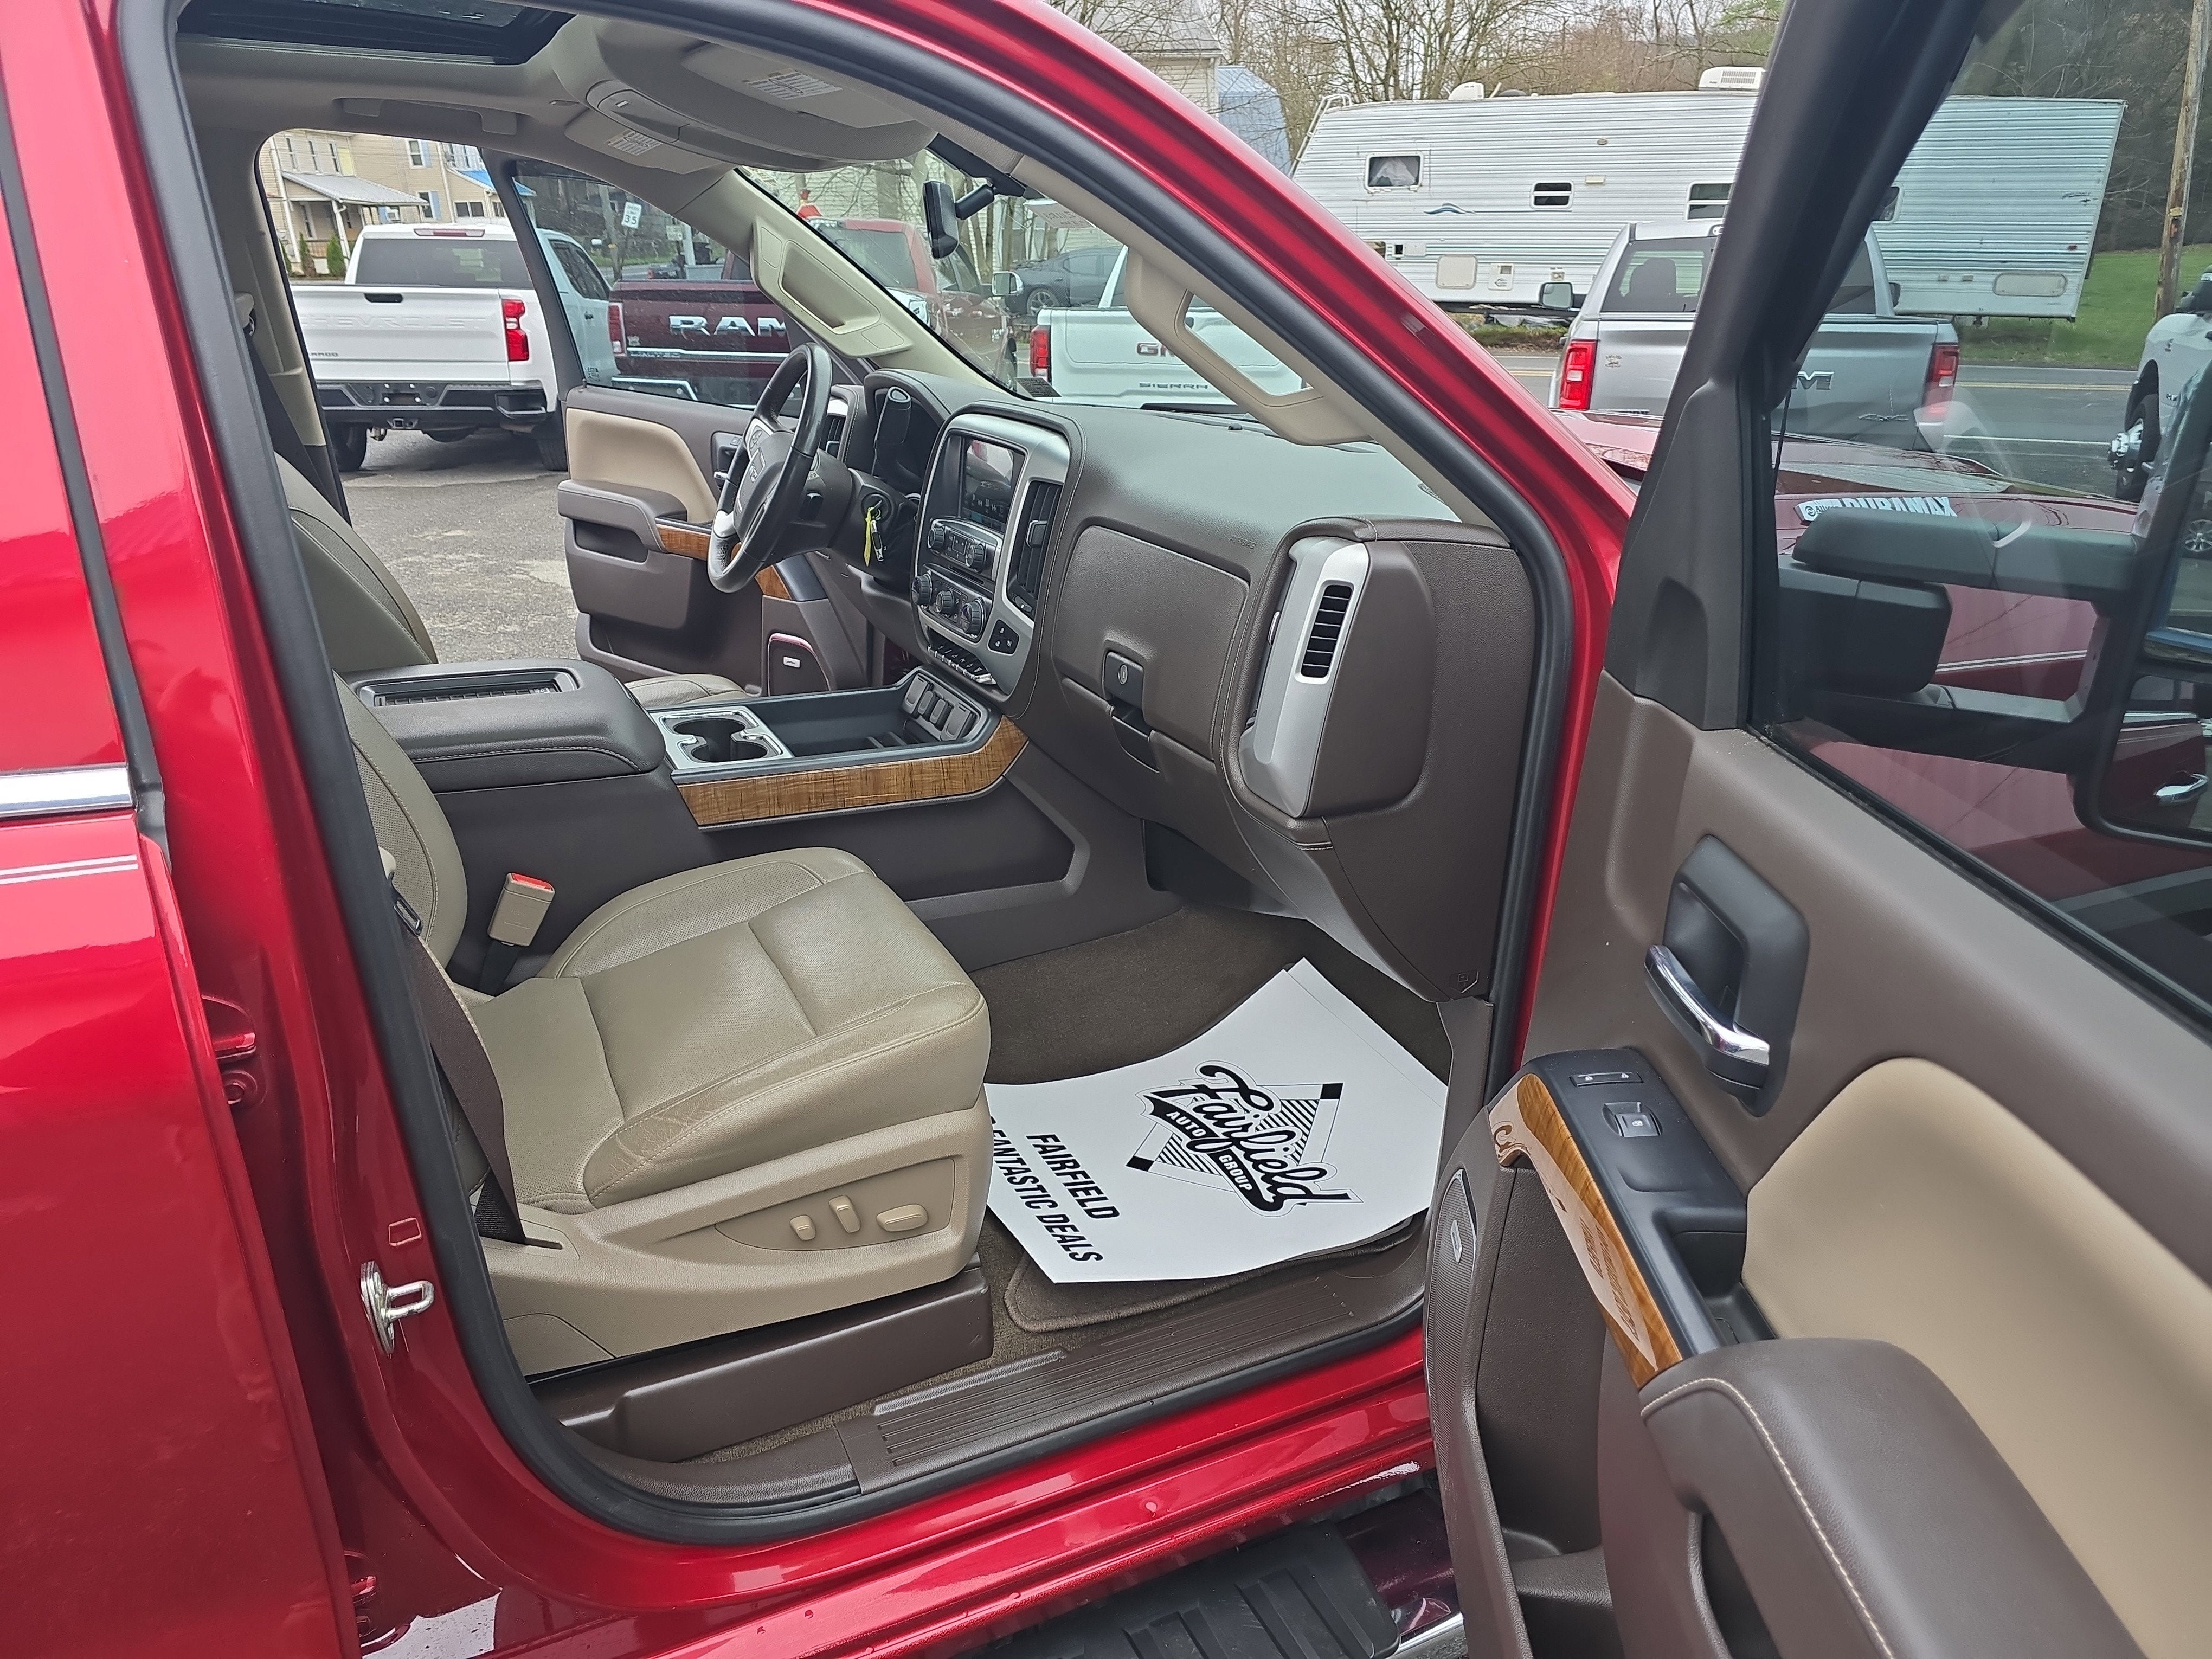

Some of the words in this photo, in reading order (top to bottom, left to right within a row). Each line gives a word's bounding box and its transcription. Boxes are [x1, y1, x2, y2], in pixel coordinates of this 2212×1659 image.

[624, 214, 637, 225] 35
[1166, 1111, 1207, 1137] AUTO
[1025, 1134, 1120, 1219] FAIRFIELD
[1218, 1154, 1253, 1191] GROUP
[1035, 1213, 1104, 1261] DEALS
